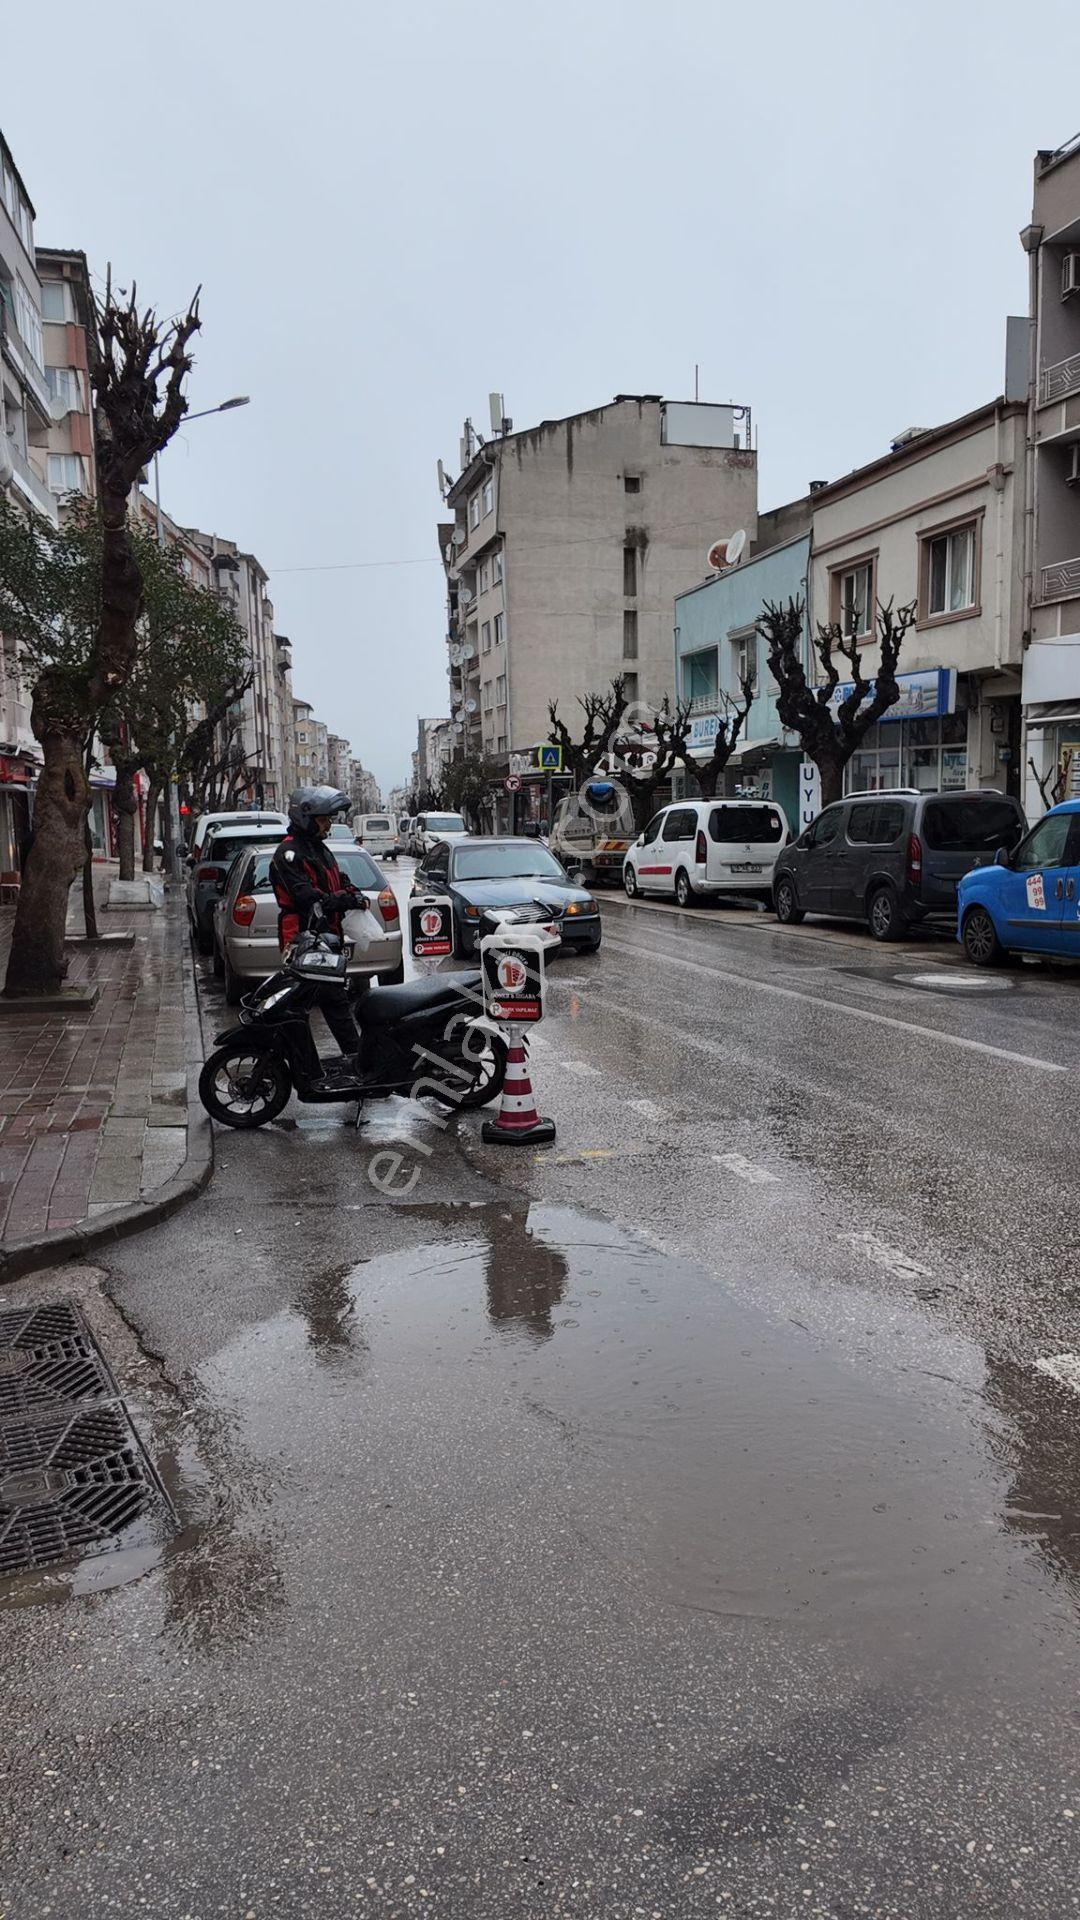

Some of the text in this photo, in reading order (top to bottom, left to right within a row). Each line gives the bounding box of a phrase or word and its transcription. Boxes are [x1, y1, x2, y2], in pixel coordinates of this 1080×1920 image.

[1028, 877, 1042, 886] 444
[1033, 887, 1043, 896] 99
[1035, 897, 1045, 907] 99
